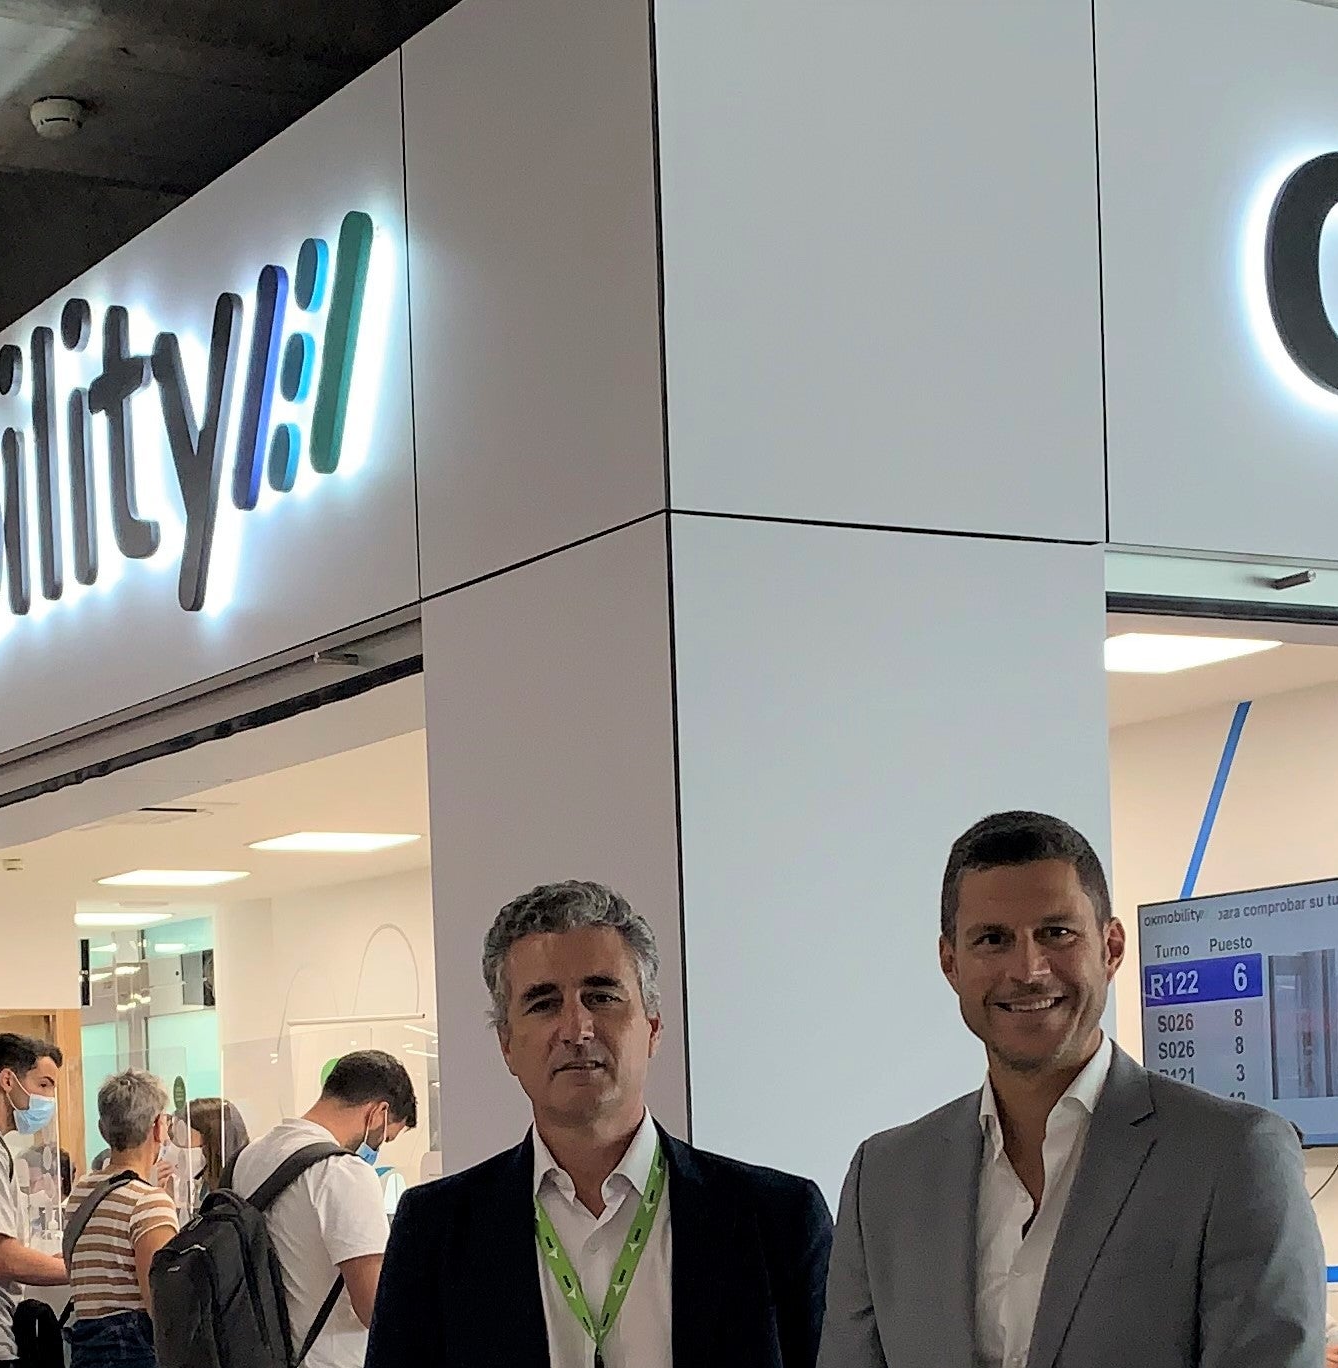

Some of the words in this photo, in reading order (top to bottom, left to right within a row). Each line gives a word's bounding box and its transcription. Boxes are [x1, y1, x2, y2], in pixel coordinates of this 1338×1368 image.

[1243, 898, 1306, 917] comprobar
[1309, 897, 1324, 909] su
[1155, 944, 1190, 958] Turno
[1209, 936, 1253, 952] Puesto
[1150, 970, 1199, 997] R122
[1233, 962, 1248, 992] 6
[1157, 1013, 1194, 1033] S026
[1234, 1008, 1243, 1026] 8
[1158, 1040, 1195, 1060] S026
[1235, 1036, 1244, 1054] 8
[1236, 1064, 1245, 1081] 3
